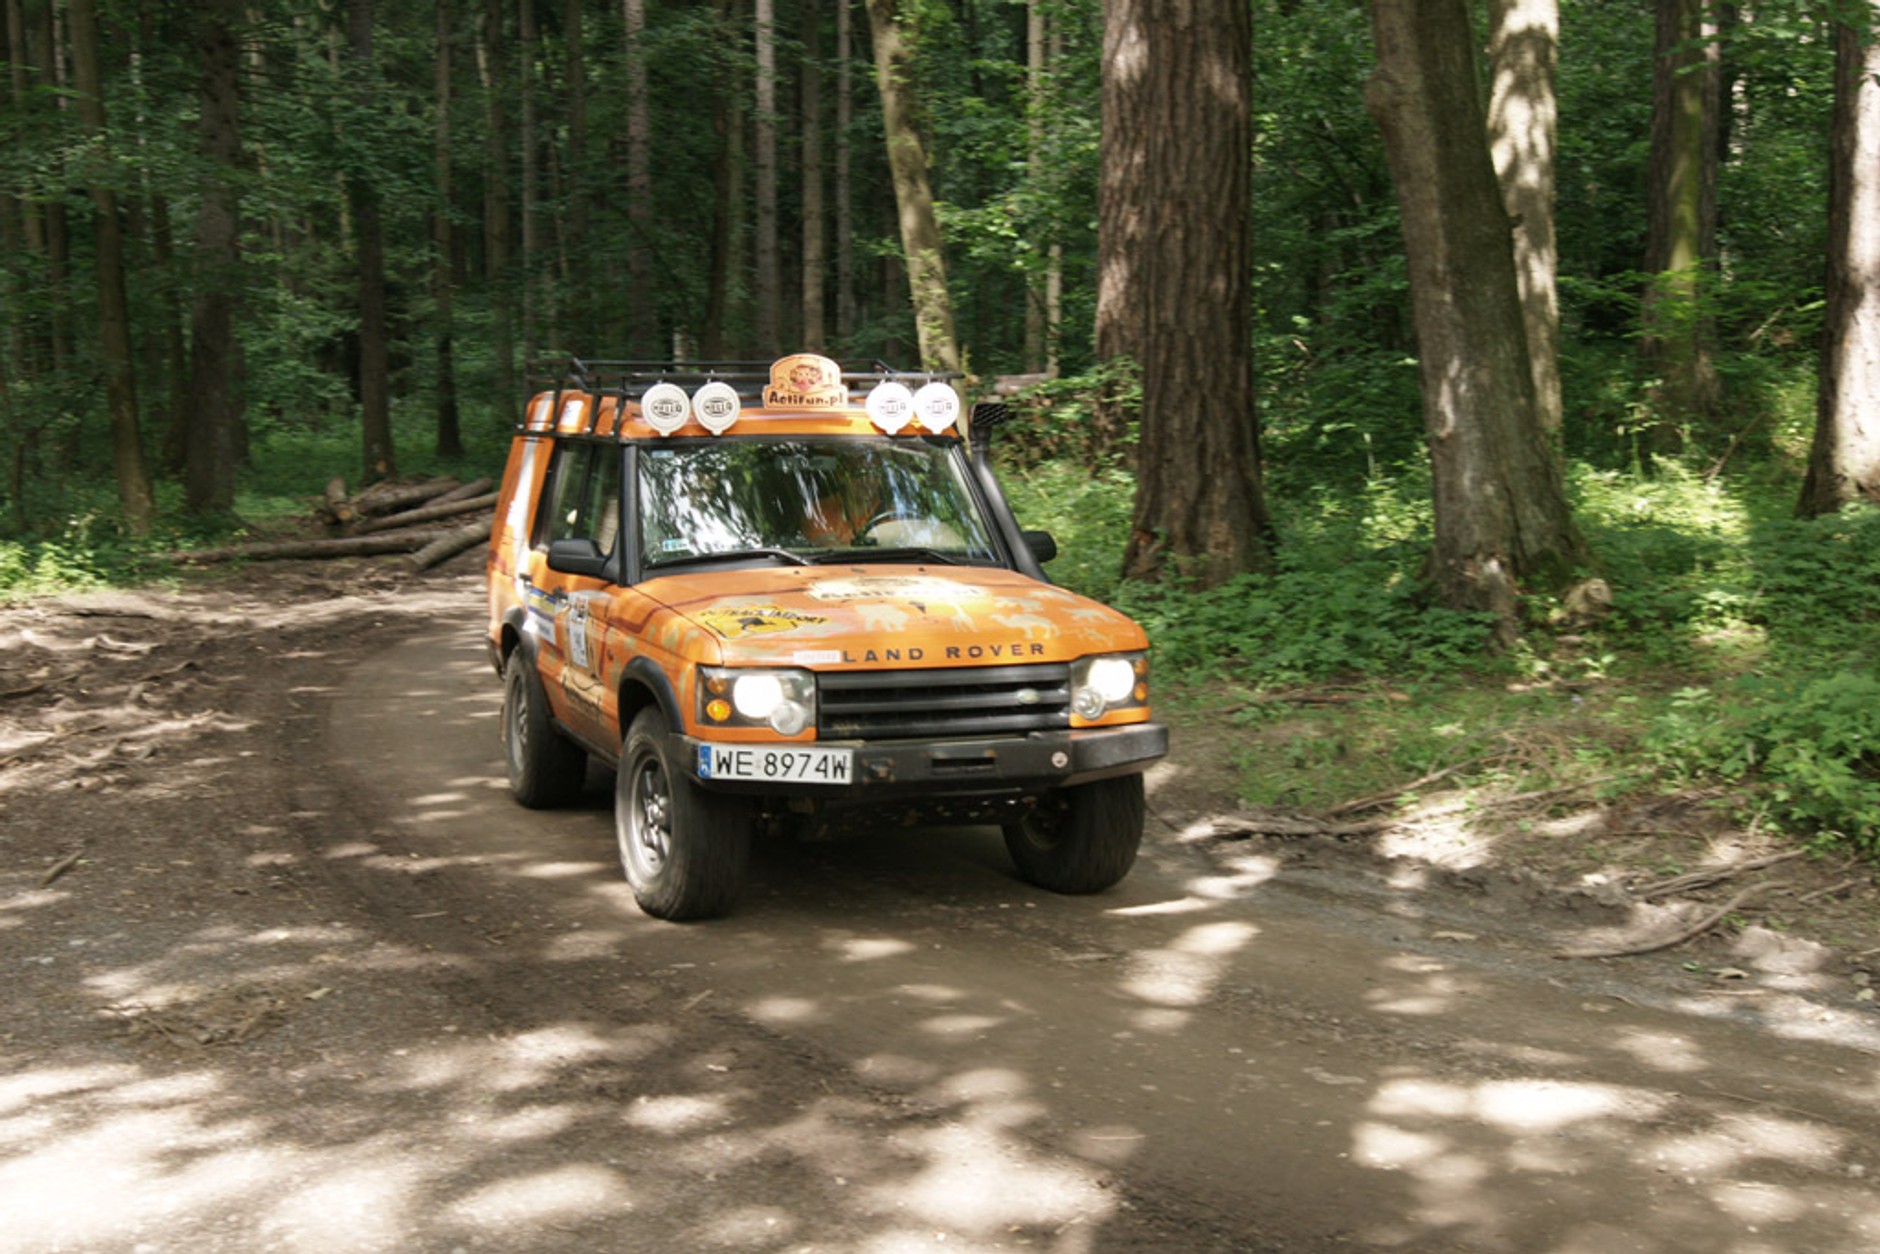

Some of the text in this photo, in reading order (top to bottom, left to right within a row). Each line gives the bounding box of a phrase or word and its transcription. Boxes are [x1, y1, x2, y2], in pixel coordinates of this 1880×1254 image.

[843, 648, 924, 662] LAND
[946, 643, 1044, 659] ROVER
[716, 750, 847, 780] WE 8974W
